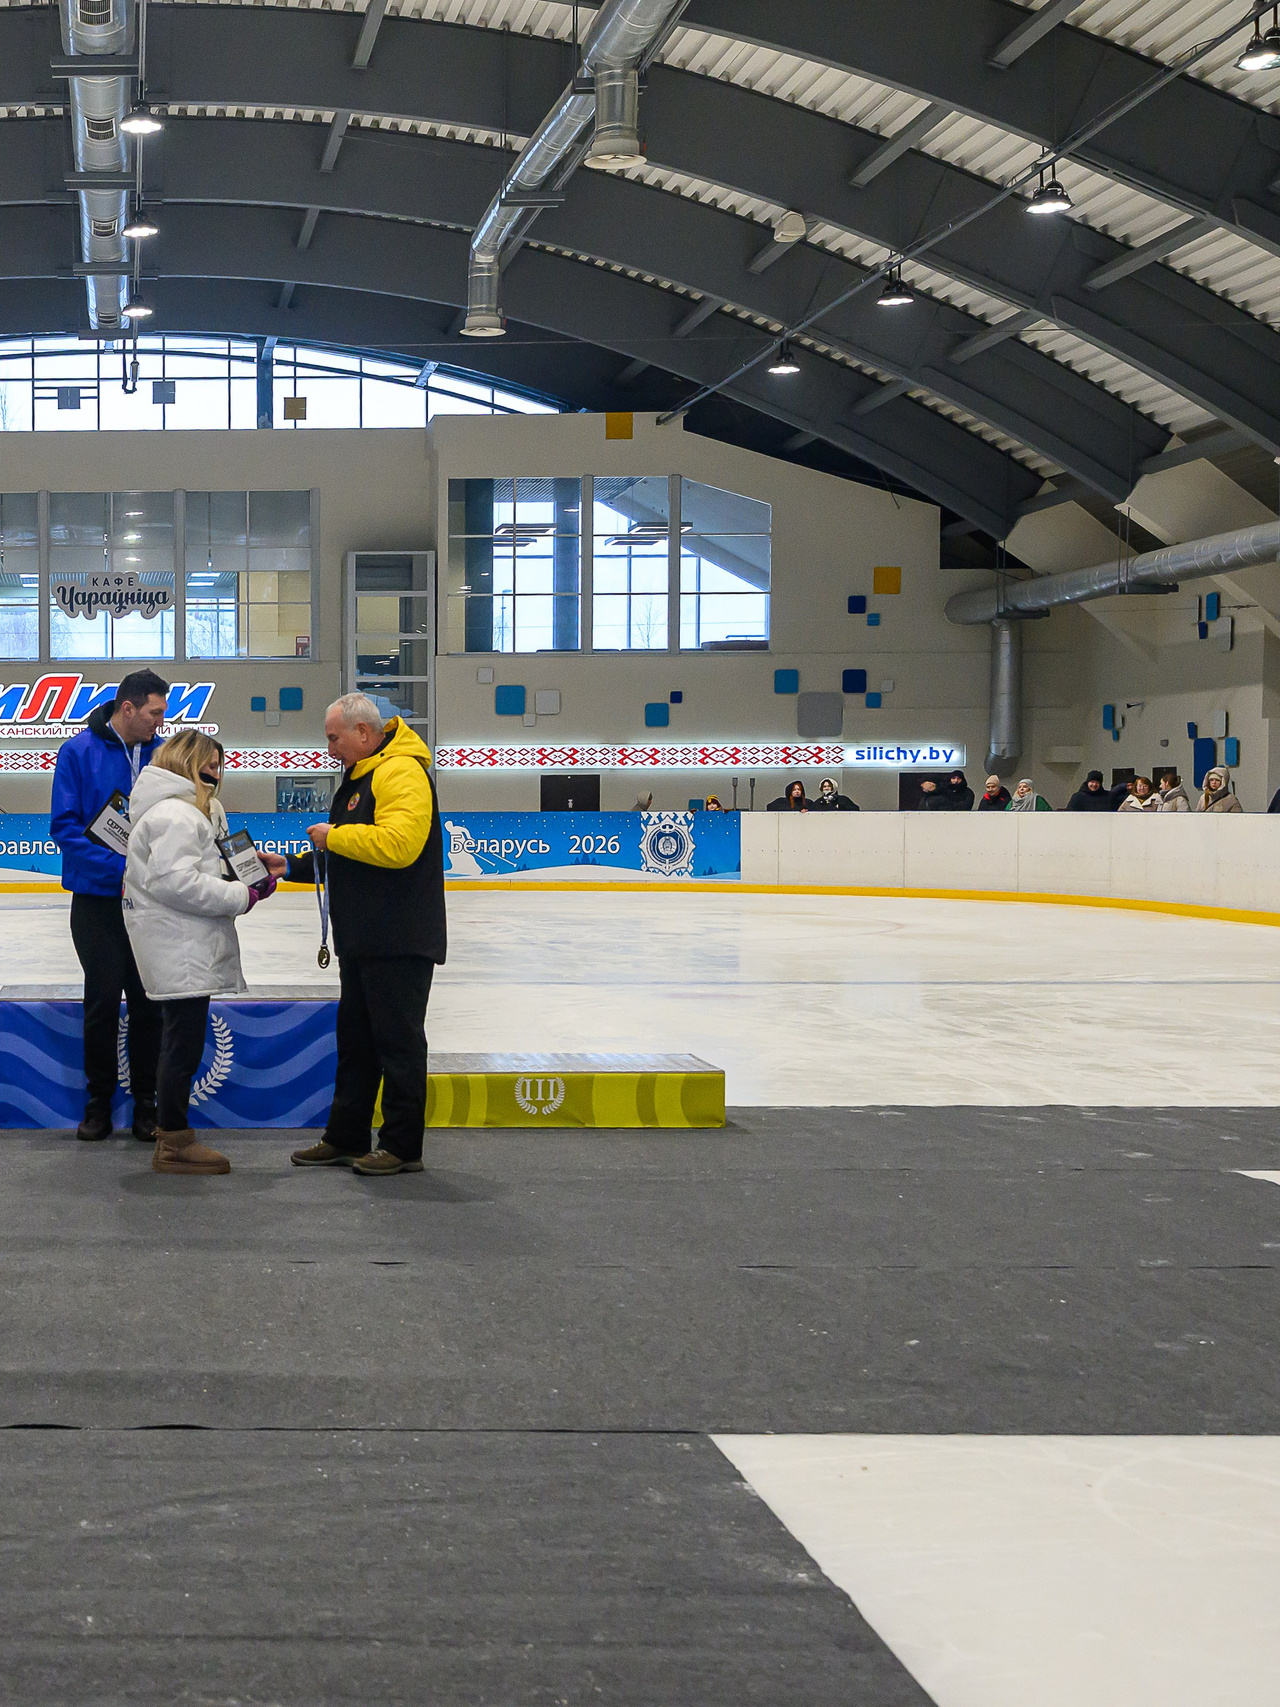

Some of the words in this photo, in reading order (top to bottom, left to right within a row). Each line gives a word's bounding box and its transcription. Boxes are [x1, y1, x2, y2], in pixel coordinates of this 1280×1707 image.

[92, 577, 134, 587] КАФЕ
[855, 747, 955, 763] silichy.by
[253, 839, 314, 857] дента
[449, 834, 551, 857] Беларусь
[568, 834, 620, 855] 2026
